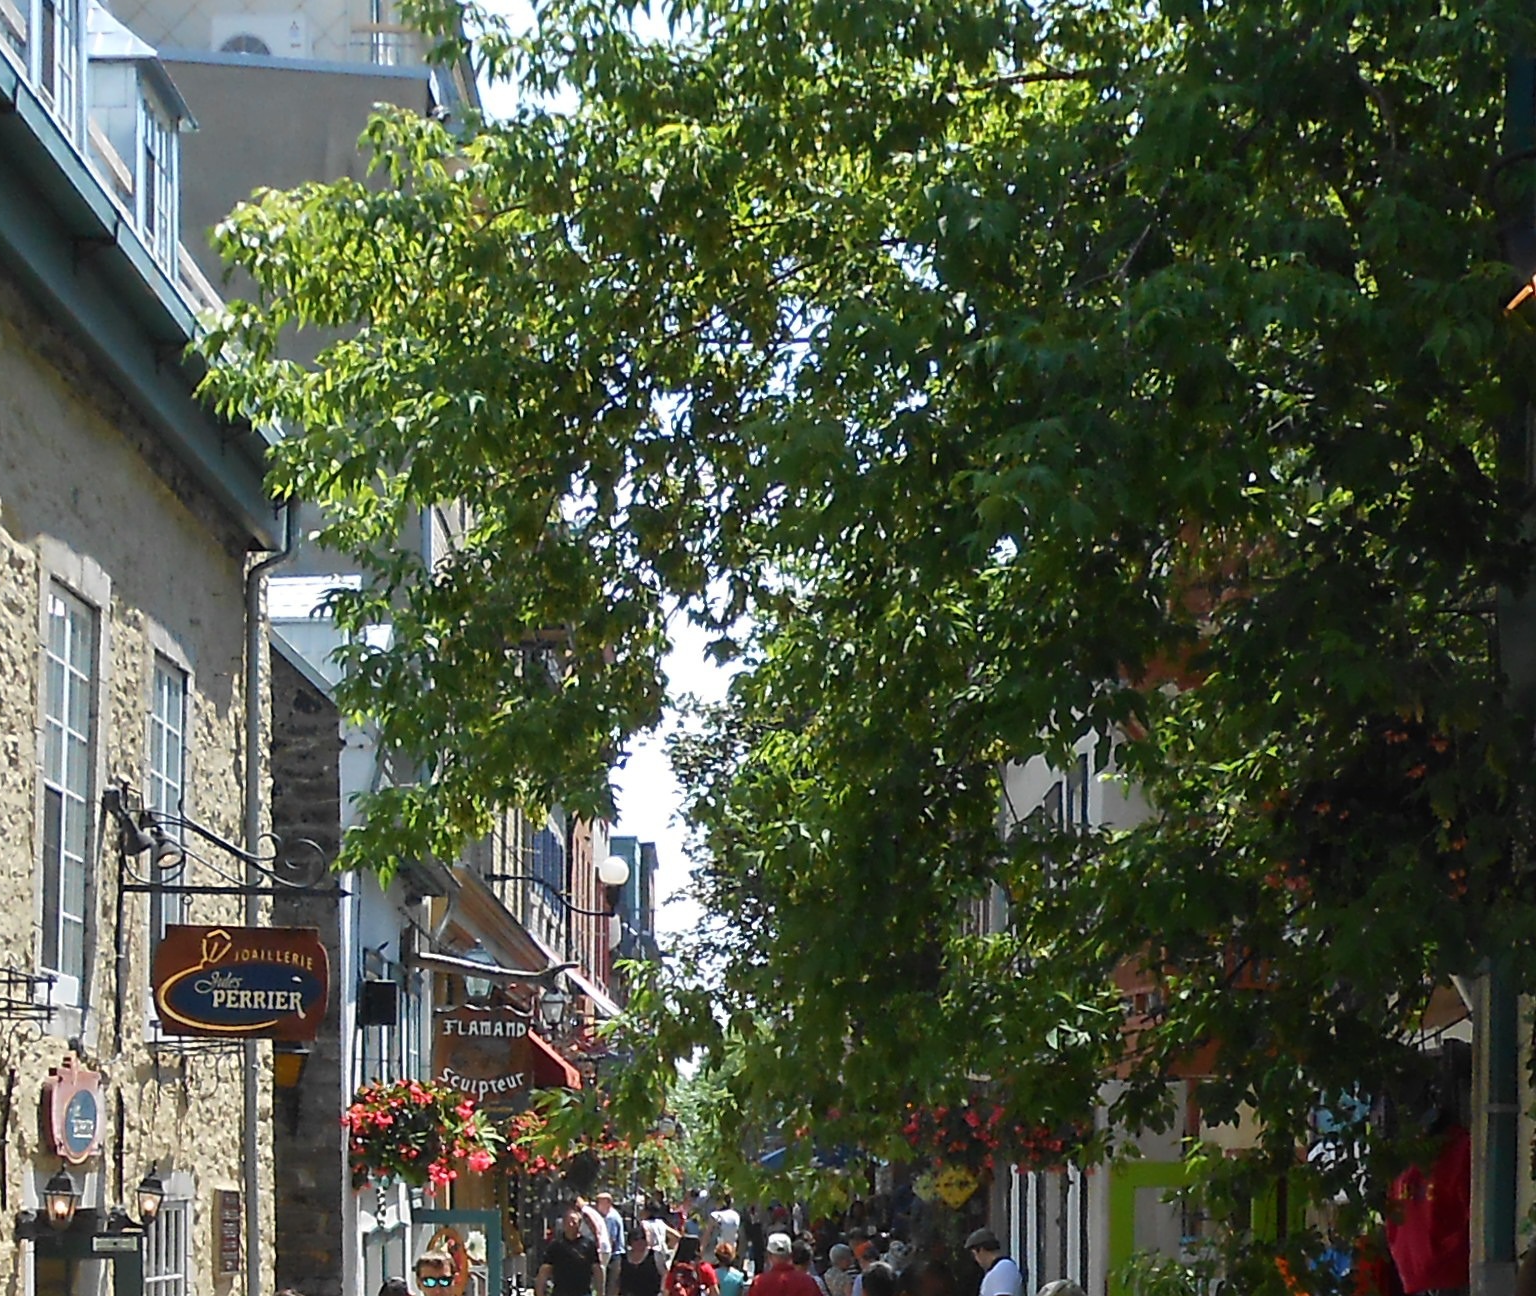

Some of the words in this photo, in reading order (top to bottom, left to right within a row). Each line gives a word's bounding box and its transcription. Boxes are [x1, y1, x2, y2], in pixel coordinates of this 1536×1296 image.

[234, 949, 314, 971] JOAILLERIE
[194, 971, 244, 994] Jules
[212, 989, 307, 1020] PERRIER
[443, 1019, 527, 1038] FLAMAND
[437, 1067, 525, 1103] Sculpteur
